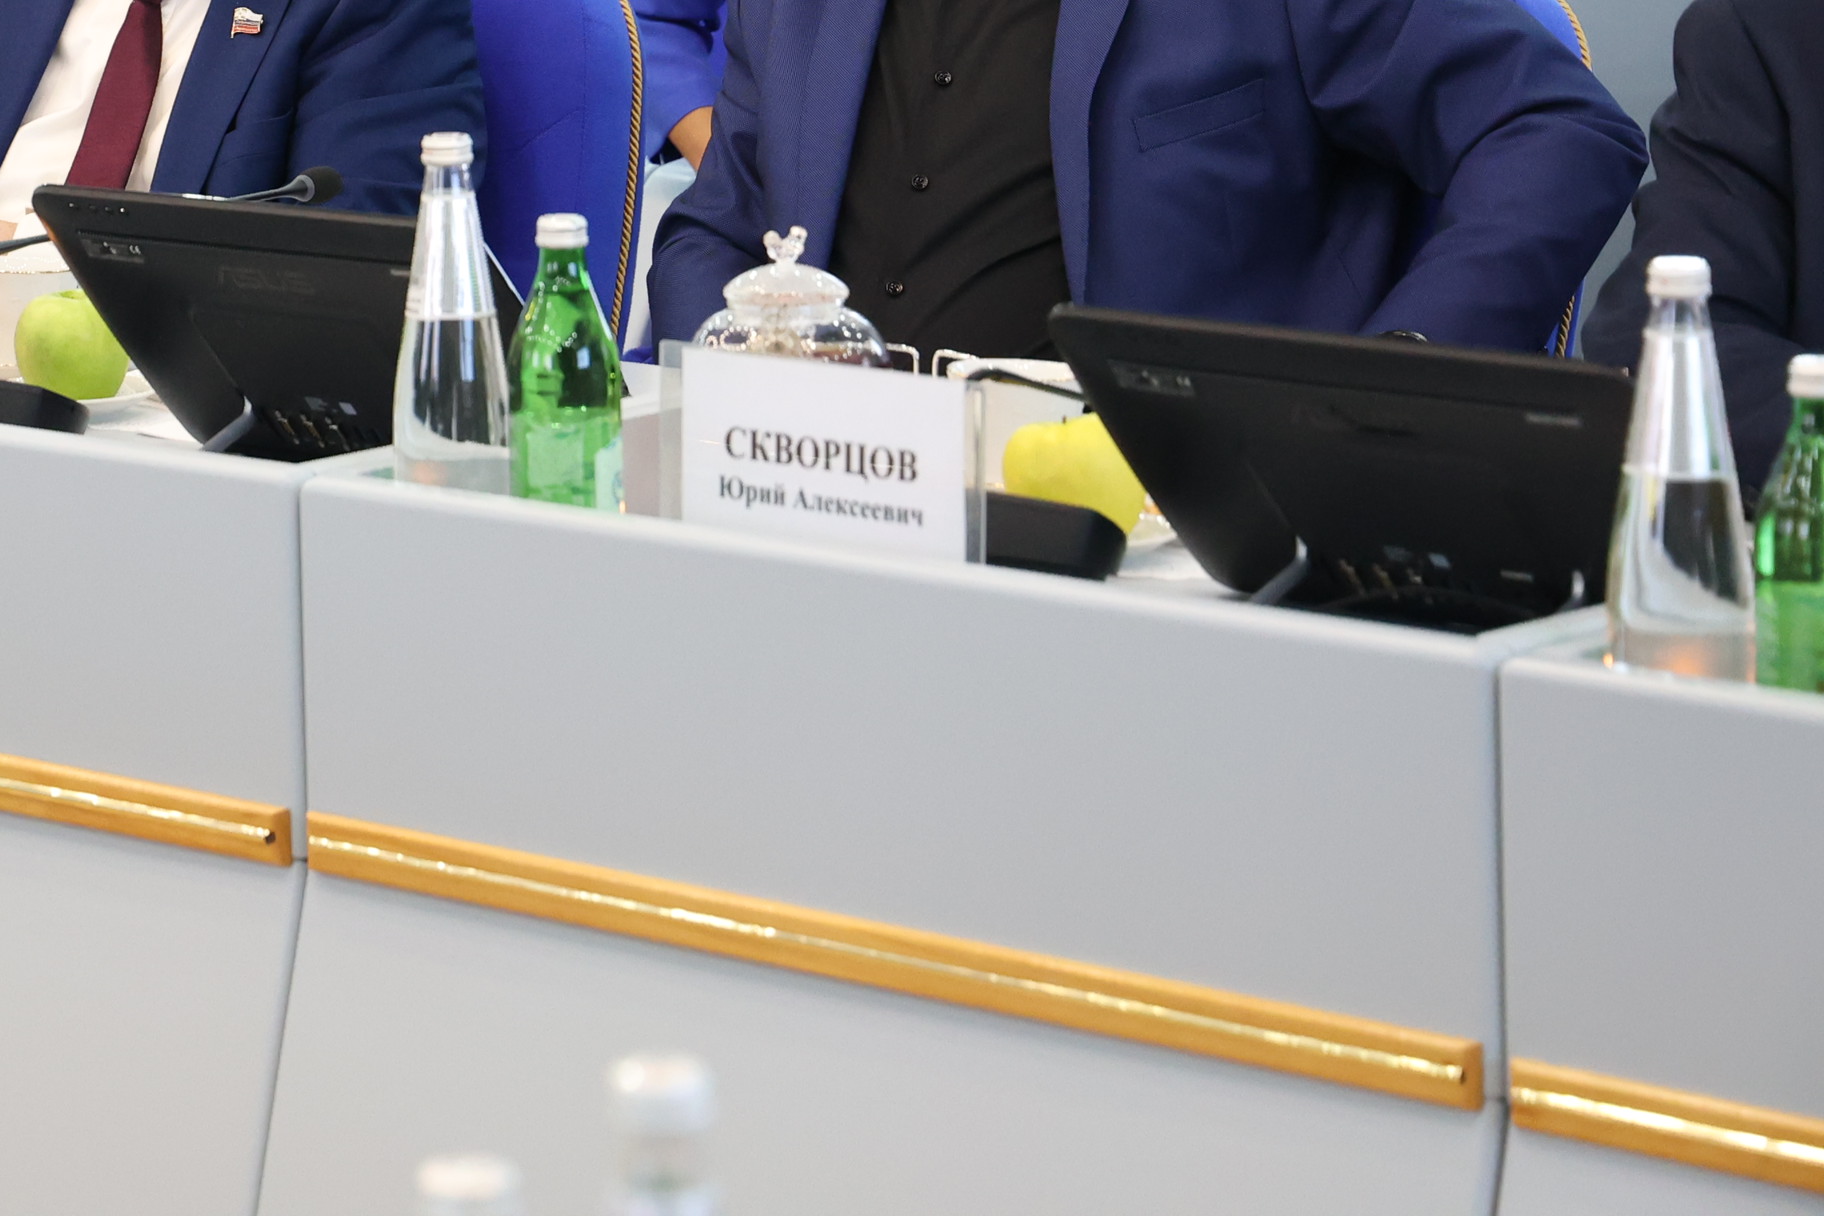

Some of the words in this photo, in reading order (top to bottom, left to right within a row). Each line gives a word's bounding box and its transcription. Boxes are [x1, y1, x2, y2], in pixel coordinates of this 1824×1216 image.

[724, 425, 918, 483] СКВОРЦОВ
[718, 474, 786, 510] Юрий
[793, 489, 924, 527] Алексеевич
